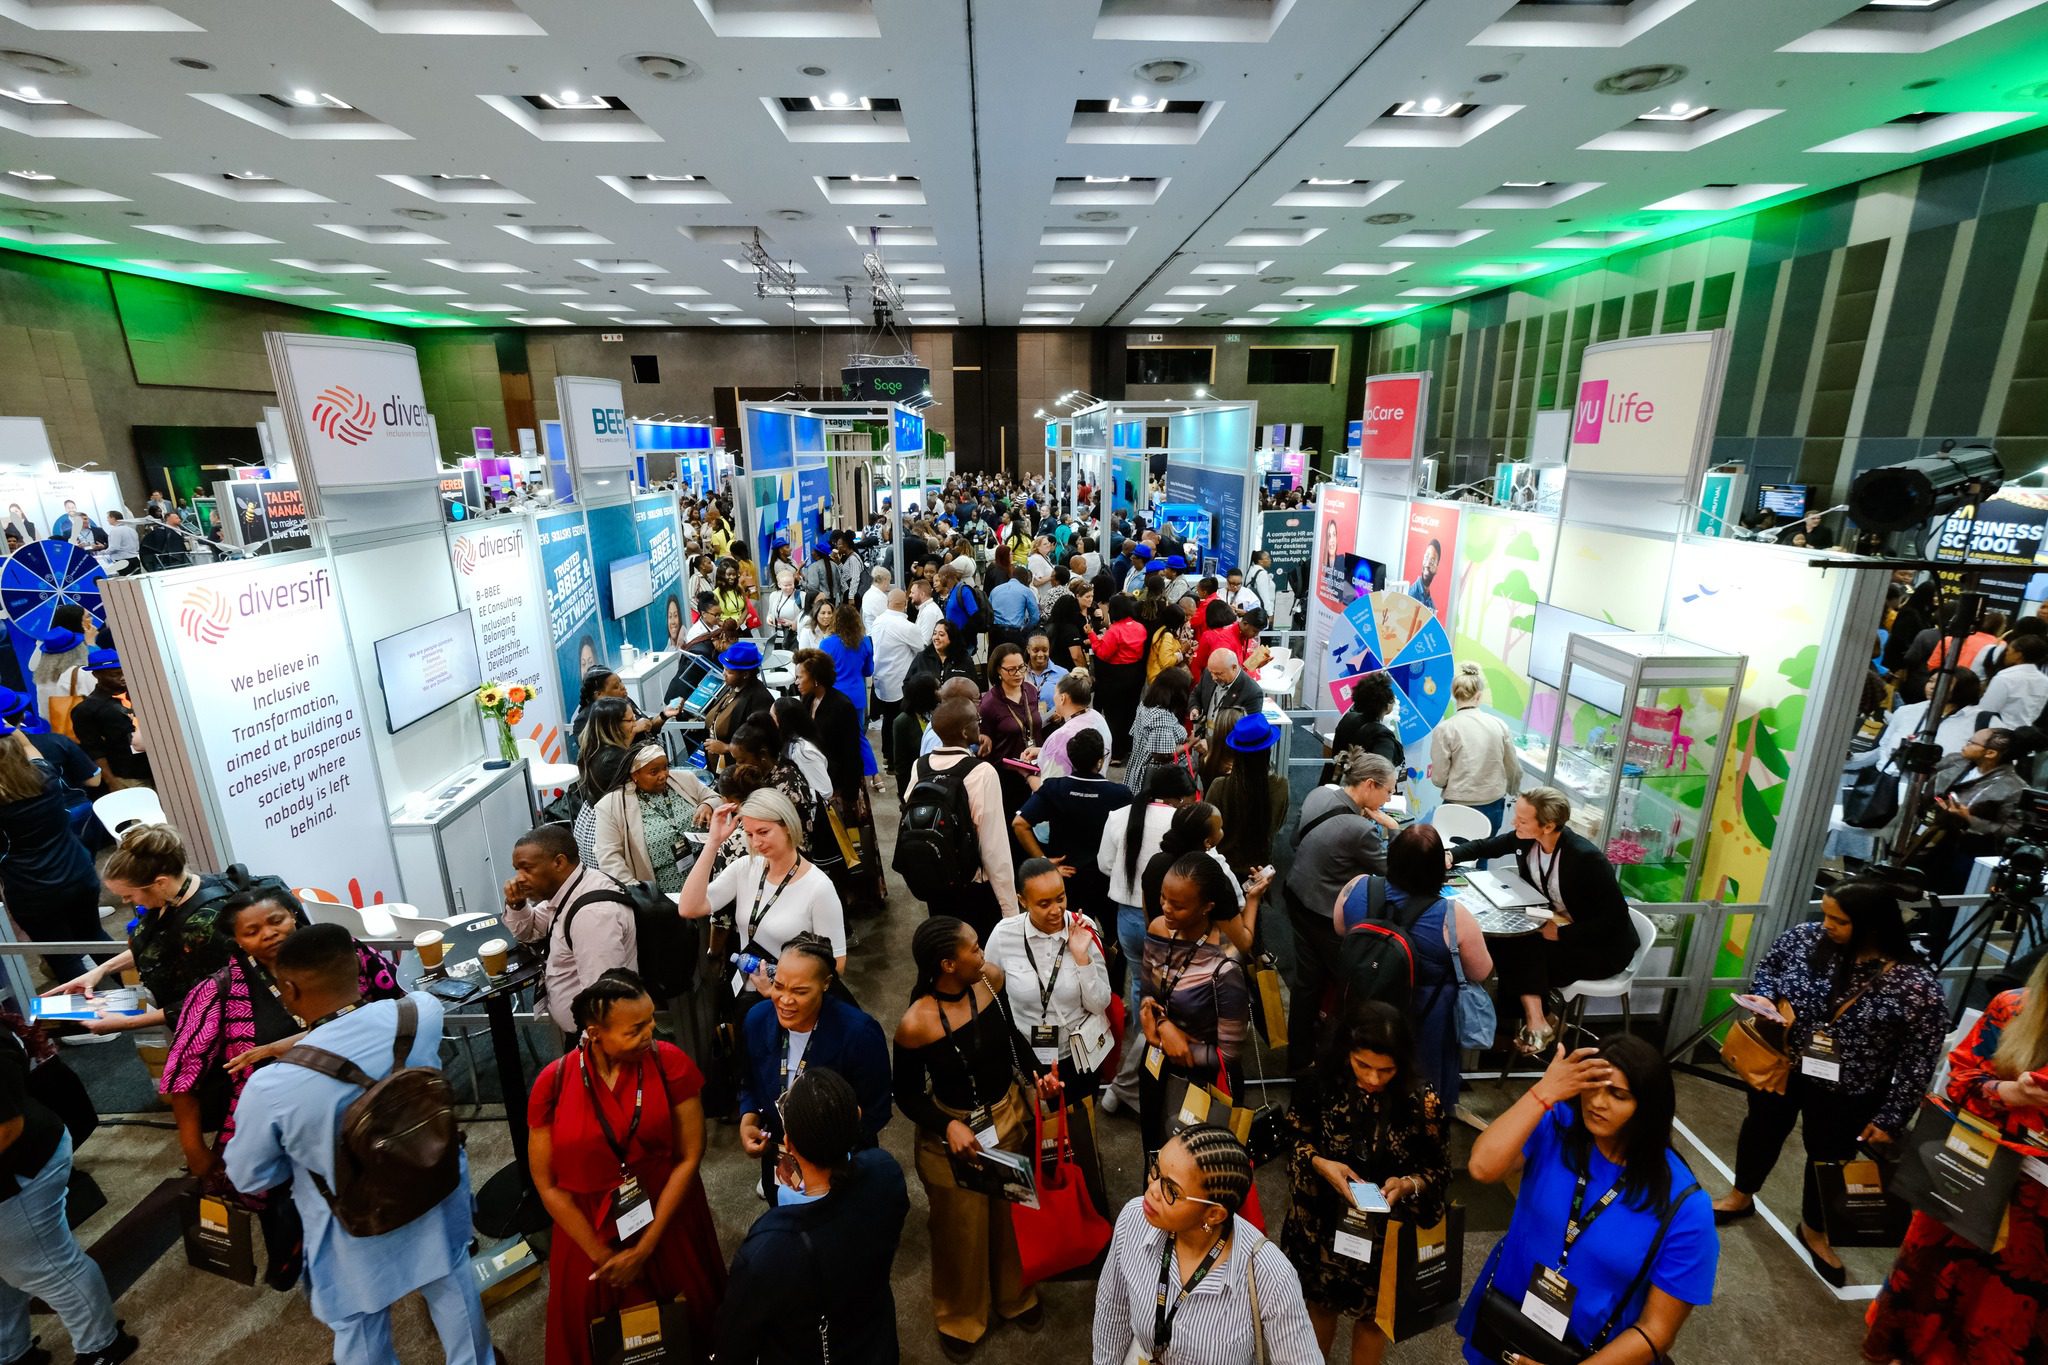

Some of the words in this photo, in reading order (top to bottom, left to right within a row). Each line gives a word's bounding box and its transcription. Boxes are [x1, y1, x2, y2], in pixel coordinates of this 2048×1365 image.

[874, 378, 903, 396] Sage
[1608, 392, 1654, 423] life
[264, 490, 303, 504] TALENT
[271, 521, 278, 529] to
[279, 520, 297, 528] make
[1945, 519, 2044, 541] BUSINESS
[479, 529, 523, 558] diversifi
[554, 551, 580, 580] TRUSTED
[583, 558, 591, 579] &
[652, 557, 680, 592] OFTWARE
[239, 569, 330, 617] diversifi
[476, 585, 500, 601] B-BBEE
[479, 605, 487, 617] EE
[487, 596, 522, 614] Consulting
[481, 615, 510, 633] Inclusion
[512, 612, 517, 622] &
[552, 588, 595, 641] SOFTWARE
[484, 626, 515, 645] Belonging
[486, 639, 521, 660] Leadership
[231, 676, 254, 693] We
[257, 659, 304, 685] believe
[307, 653, 320, 668] in
[488, 646, 530, 671] Development
[253, 680, 310, 710] Inclusive
[232, 694, 339, 744] Transformation,
[226, 740, 271, 772] aimed
[274, 734, 289, 751] at
[291, 714, 342, 743] building
[346, 708, 353, 721] a
[228, 760, 291, 797] cohesive,
[293, 727, 361, 770] prosperous
[258, 775, 305, 808] society
[307, 755, 346, 782] where
[265, 794, 314, 829] nobody
[316, 787, 327, 801] is
[329, 773, 350, 795] left
[291, 803, 337, 838] behind.
[625, 1335, 642, 1350] HR
